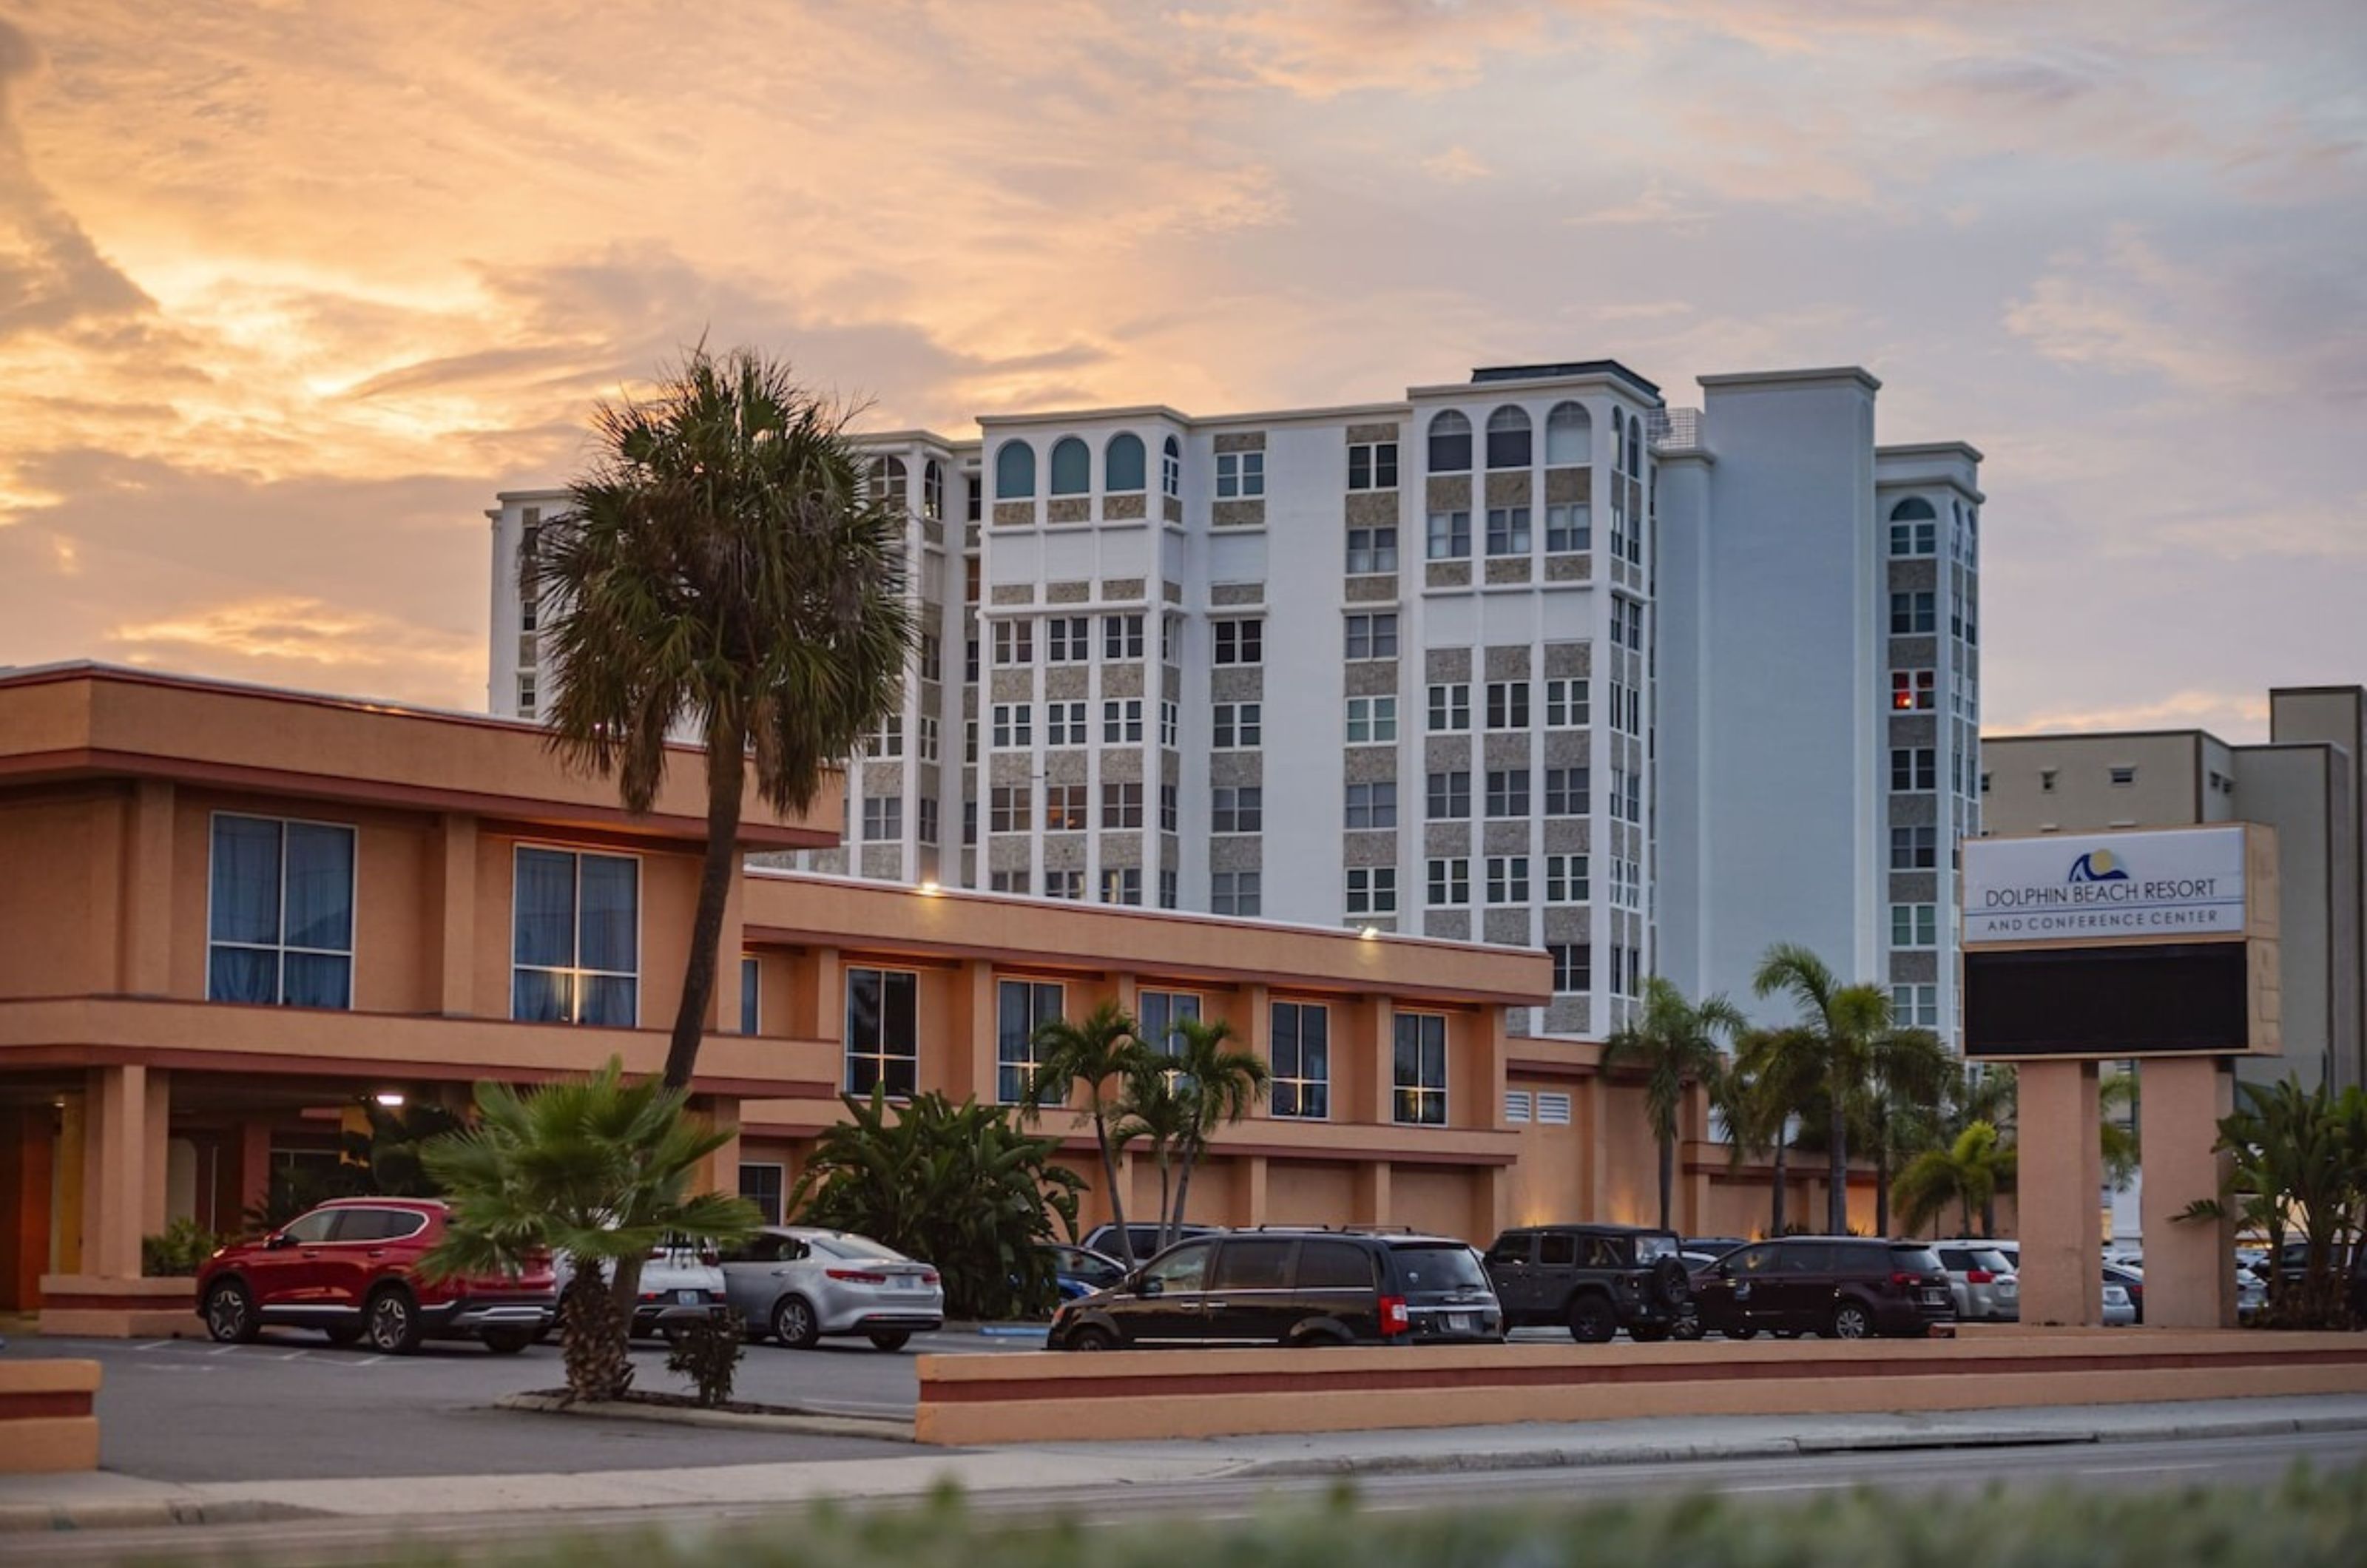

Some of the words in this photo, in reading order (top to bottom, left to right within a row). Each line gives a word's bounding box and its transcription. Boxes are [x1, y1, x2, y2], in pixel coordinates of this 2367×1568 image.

[1986, 888, 2068, 908] DOLPHIN
[2074, 882, 2138, 903] BEACH
[2145, 878, 2216, 900] RESORT
[1988, 919, 2023, 931] AND
[2028, 913, 2144, 930] CONFERENCE
[2150, 910, 2218, 925] CENTER
